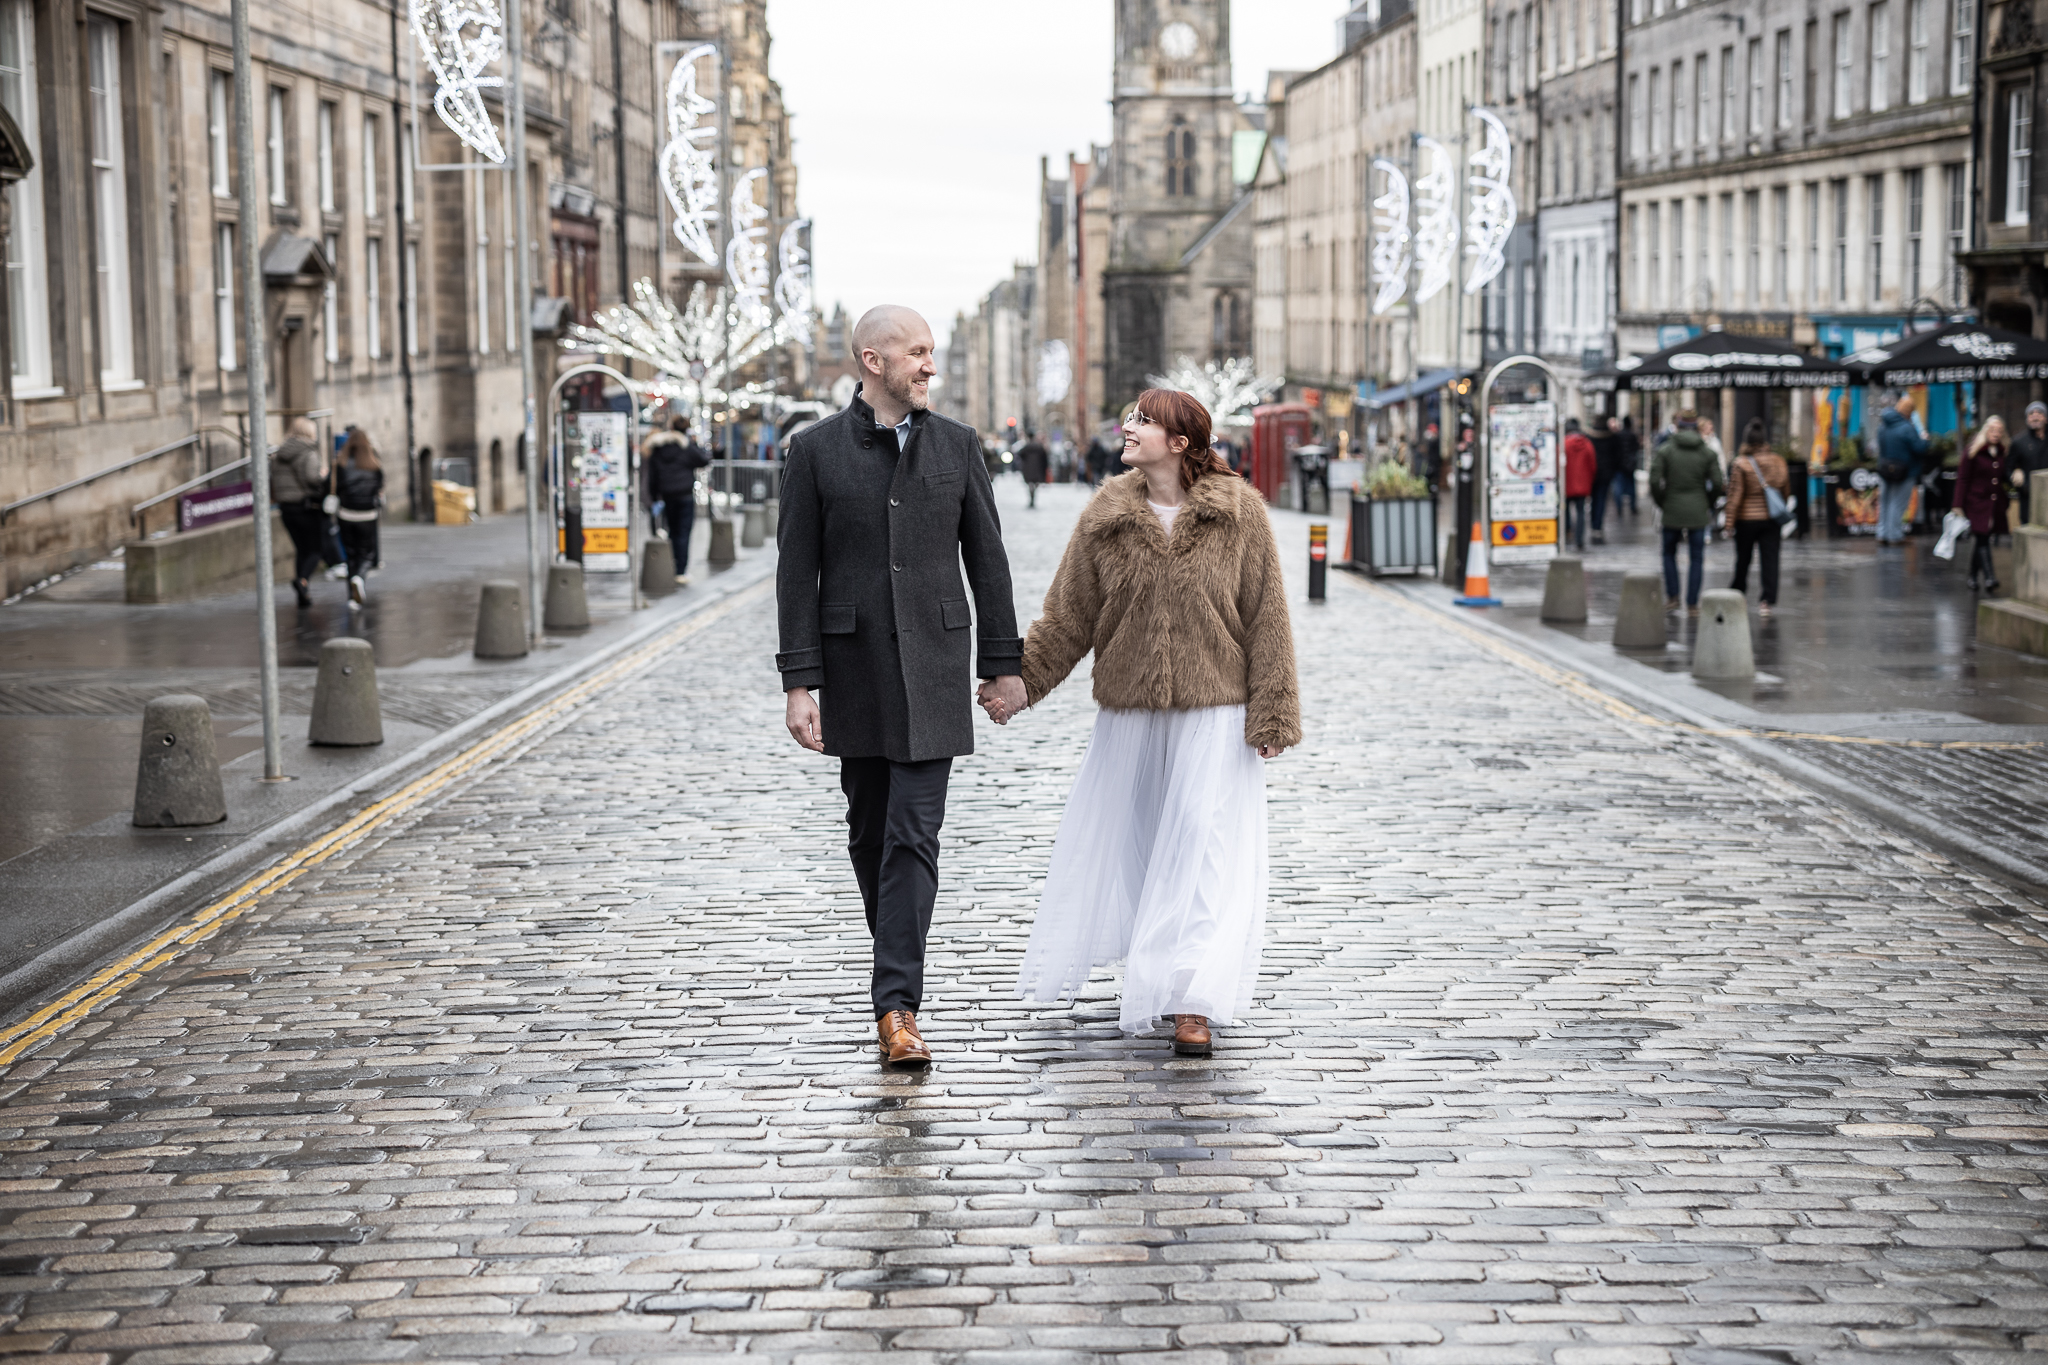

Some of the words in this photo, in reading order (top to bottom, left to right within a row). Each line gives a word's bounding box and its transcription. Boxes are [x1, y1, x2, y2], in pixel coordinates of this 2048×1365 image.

[1630, 375, 1671, 390] PIZZA
[1682, 372, 1721, 388] BEER
[1734, 371, 1770, 386] WINE
[1782, 371, 1849, 386] SUNDAES
[1884, 369, 1924, 386] PIZZA
[1936, 366, 1975, 383] BEER
[1988, 364, 2024, 379] WINE
